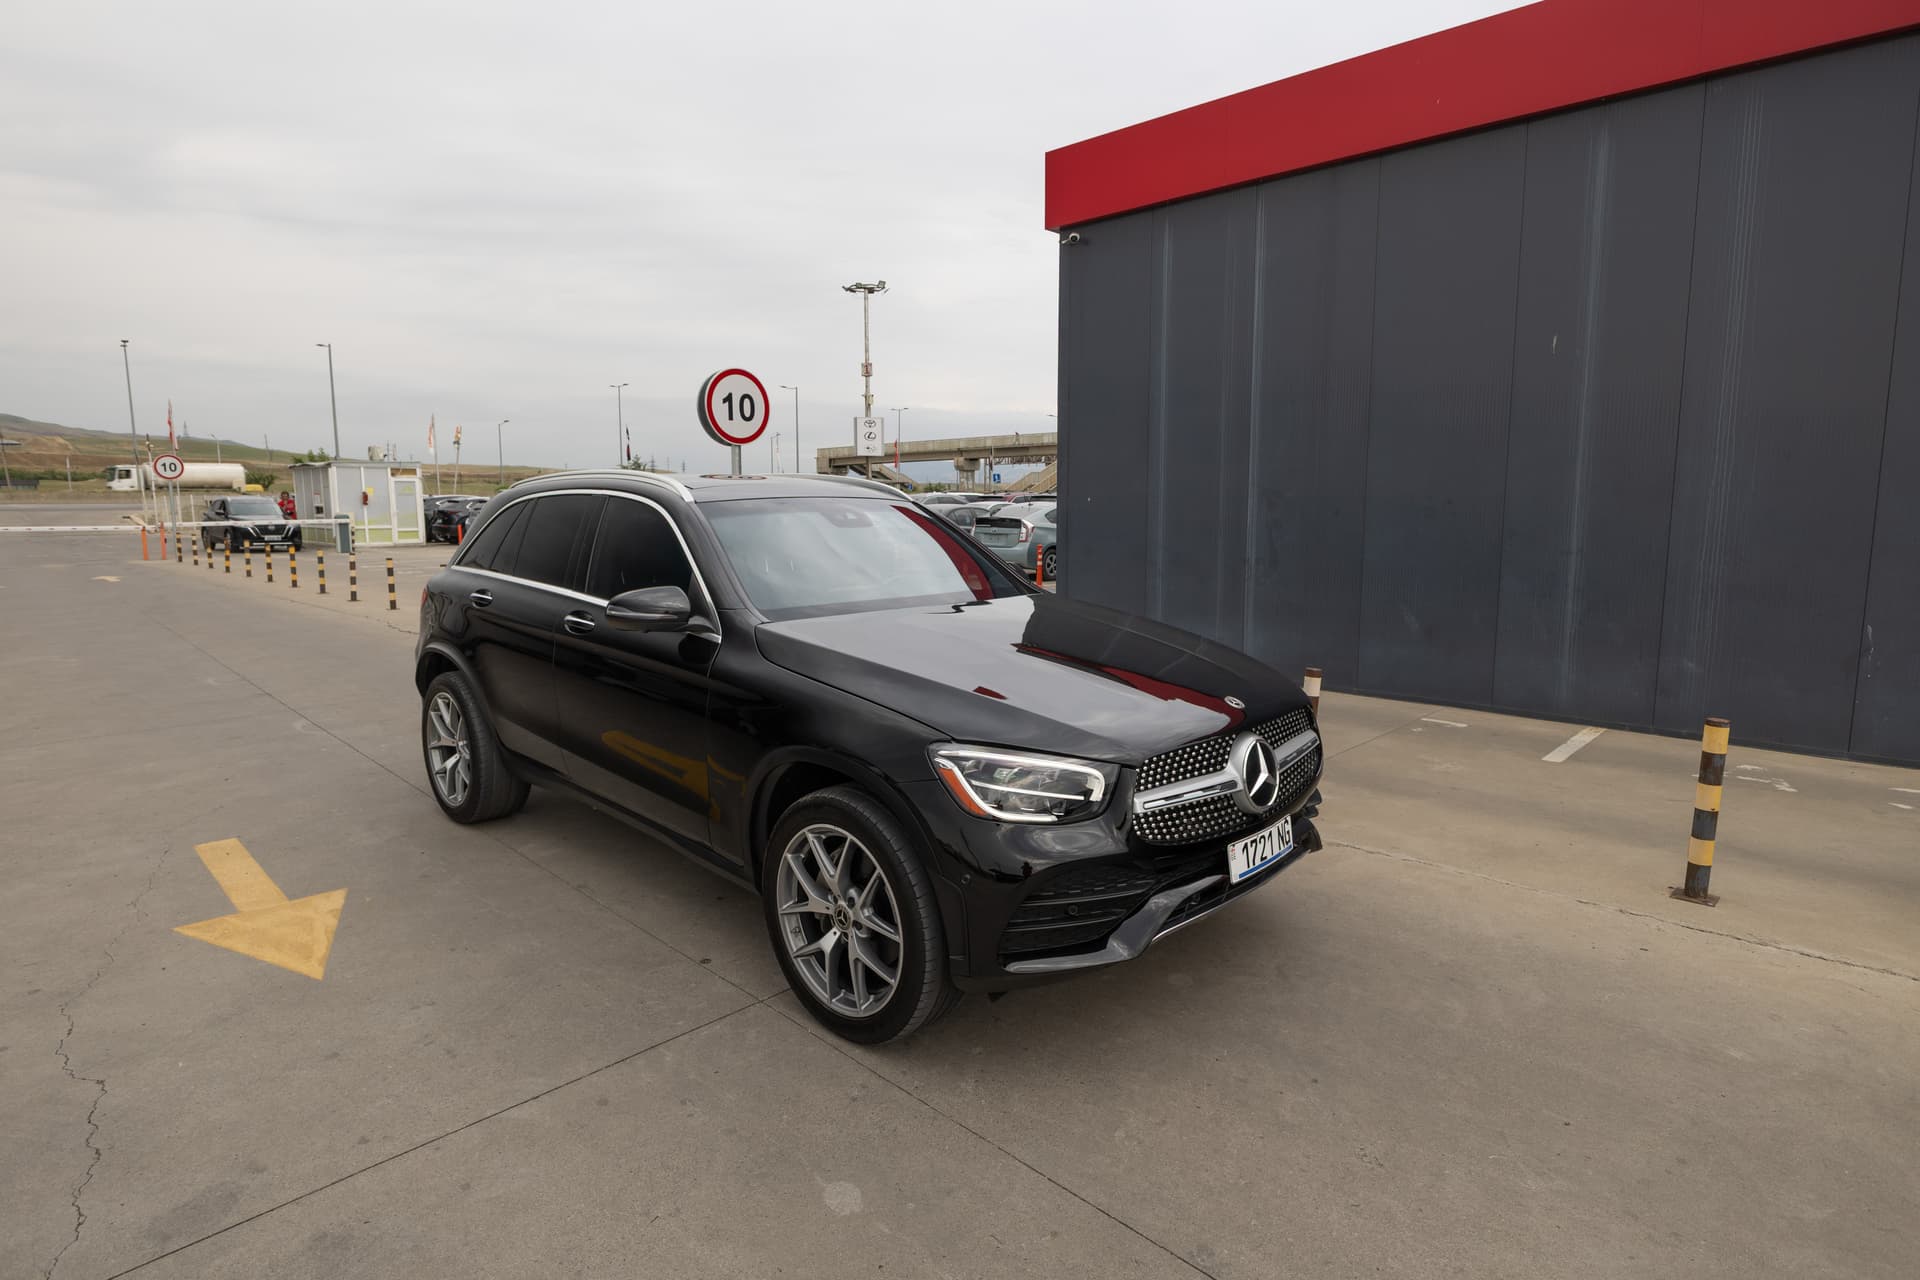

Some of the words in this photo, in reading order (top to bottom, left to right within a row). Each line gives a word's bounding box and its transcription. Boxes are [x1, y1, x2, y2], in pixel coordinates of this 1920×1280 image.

[722, 392, 755, 422] 10
[161, 462, 177, 472] 10
[1242, 830, 1274, 869] 1721
[1277, 819, 1291, 851] NG
